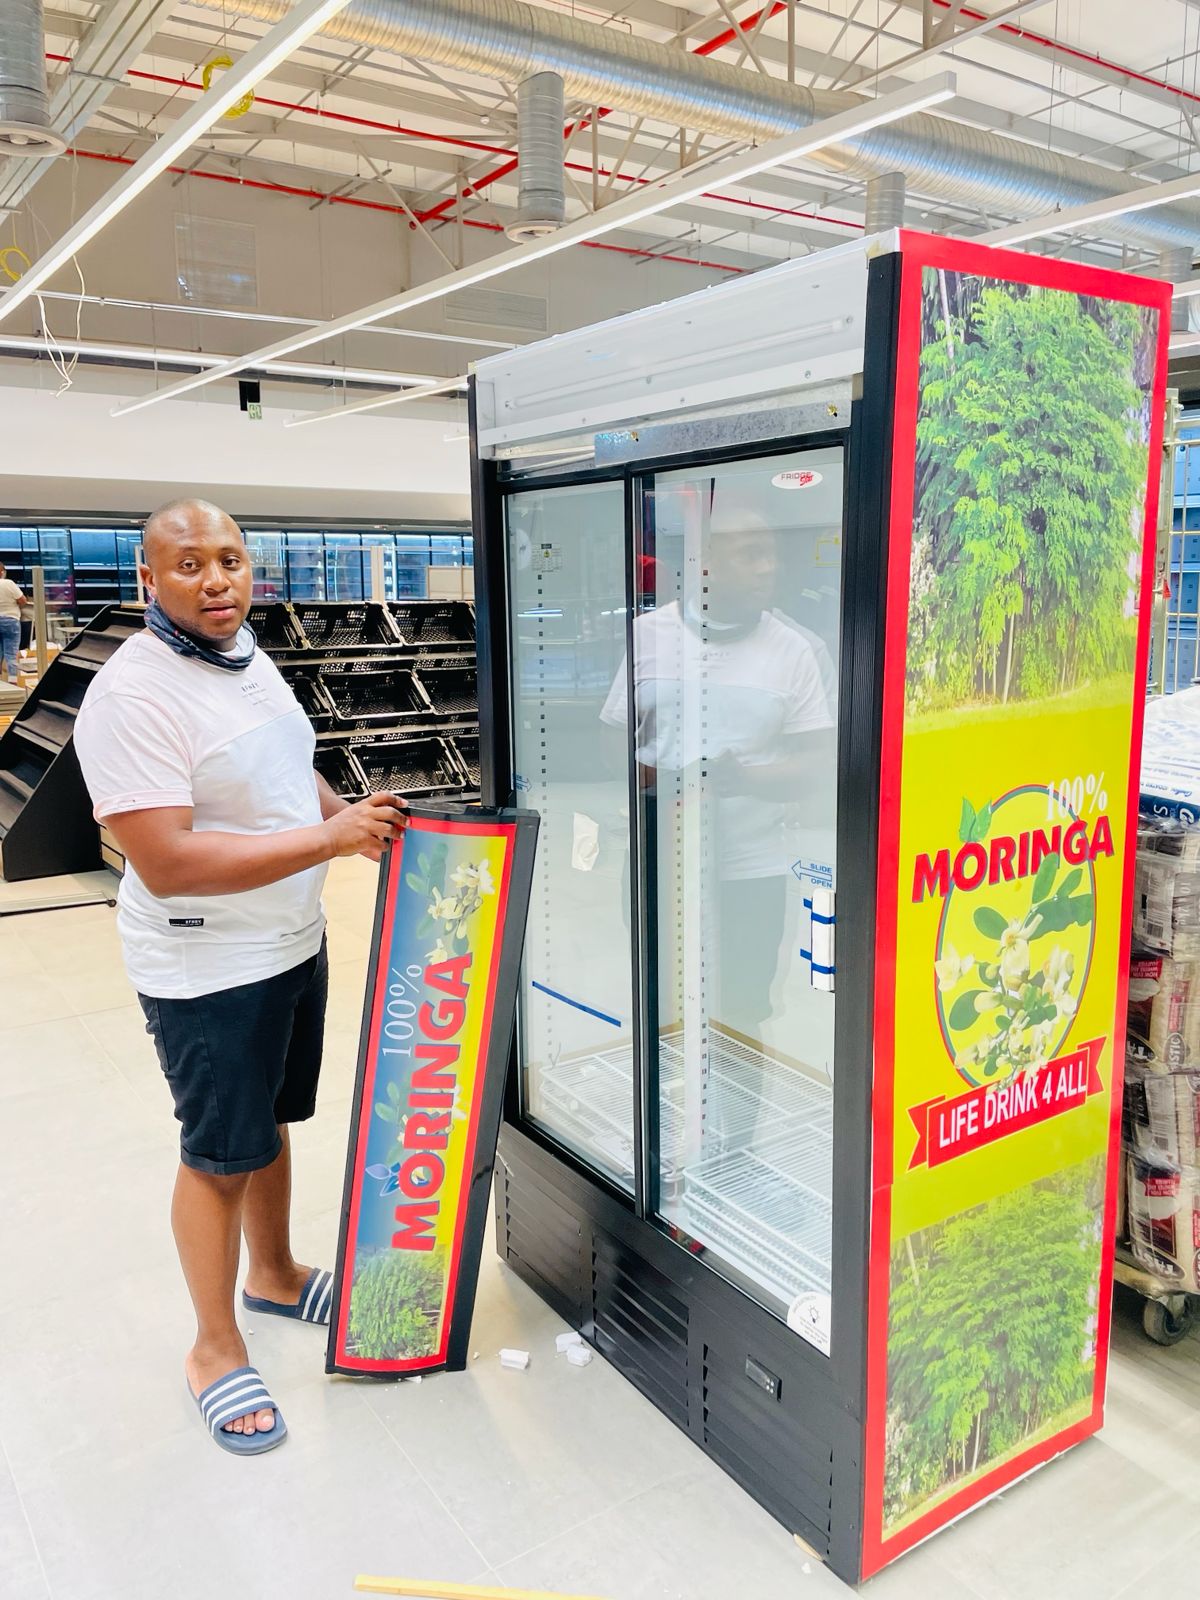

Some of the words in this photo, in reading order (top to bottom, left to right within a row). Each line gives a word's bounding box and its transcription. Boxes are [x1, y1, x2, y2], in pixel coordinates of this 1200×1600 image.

[1045, 771, 1108, 821] 100%
[810, 863, 832, 873] SLIDE
[811, 878, 832, 888] OPEN
[911, 815, 1114, 903] MORINGA
[382, 963, 423, 1058] 100%
[391, 952, 473, 1252] MORINGA
[939, 1099, 979, 1148] LIFE
[984, 1075, 1039, 1129] DRINK
[1042, 1076, 1052, 1104] 4
[1055, 1060, 1087, 1101] ALL
